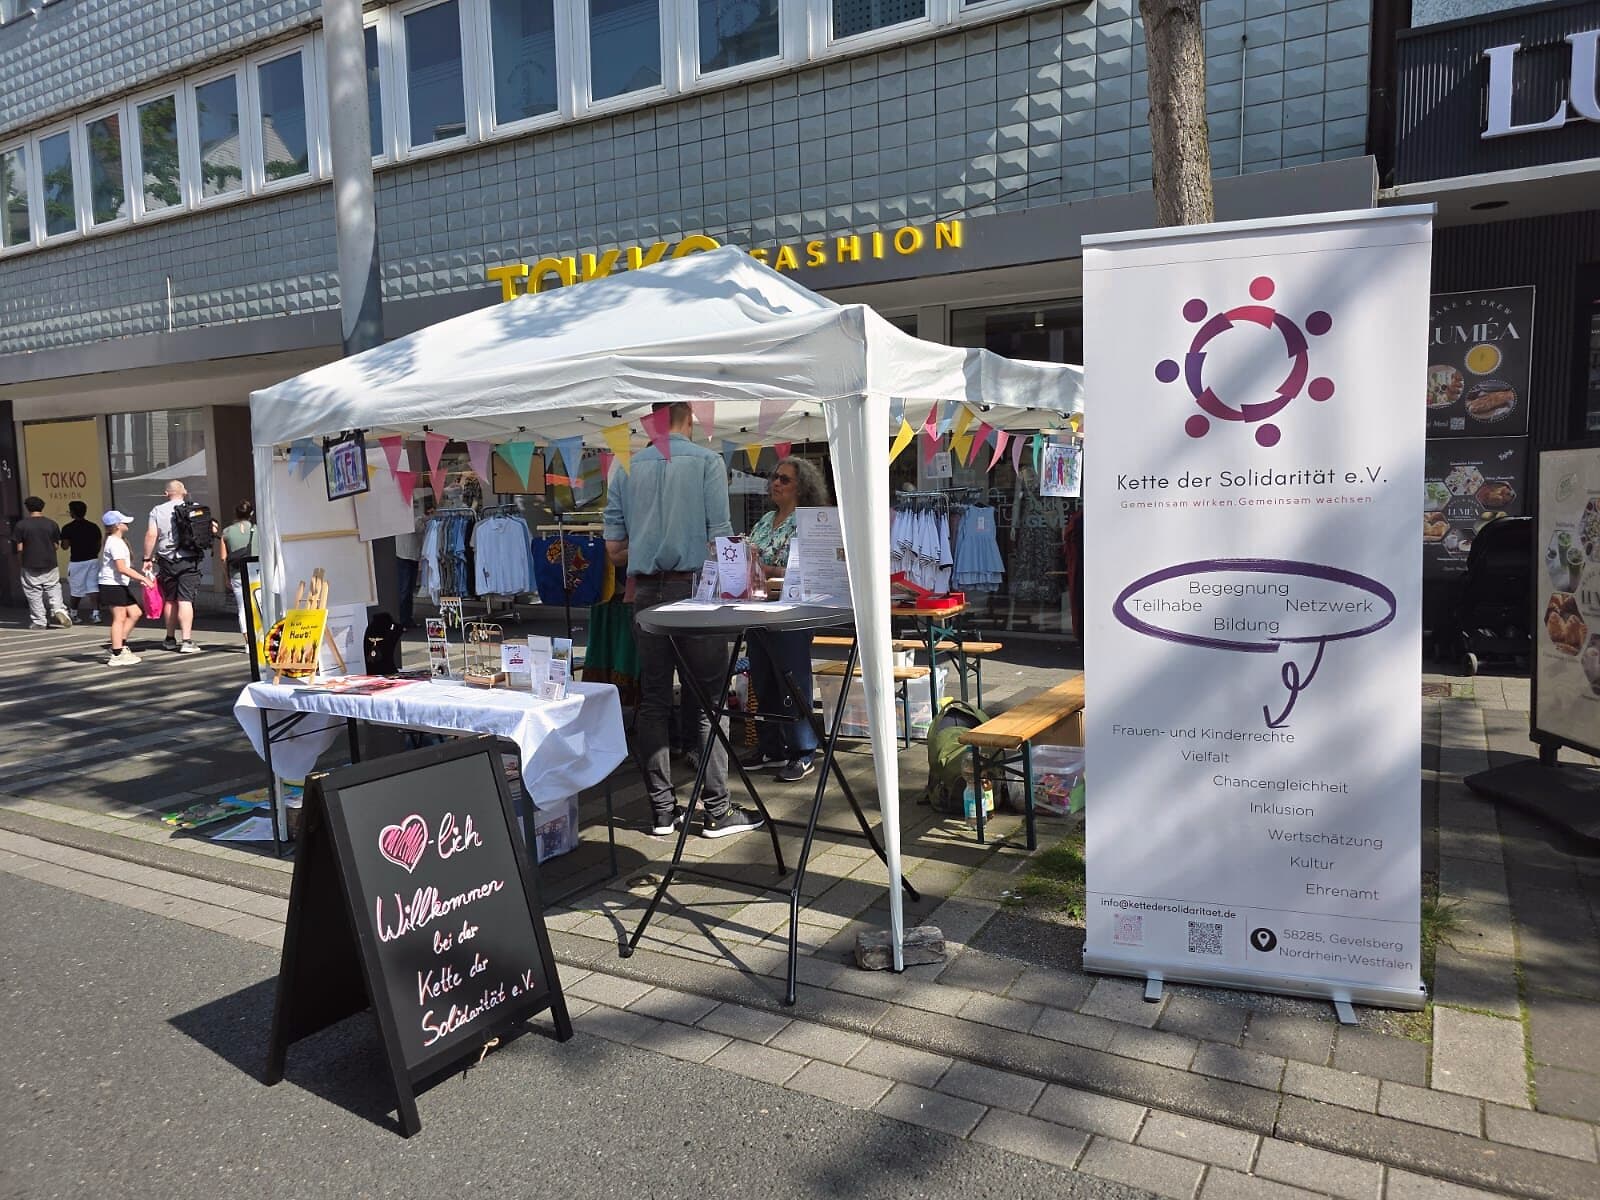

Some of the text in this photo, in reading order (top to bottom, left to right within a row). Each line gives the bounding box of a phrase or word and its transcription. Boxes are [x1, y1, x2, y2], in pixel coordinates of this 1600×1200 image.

[1429, 316, 1521, 346] UMÉA
[1117, 465, 1387, 490] Kette der Solidarität e.V.
[1120, 499, 1188, 509] Gemeinsam
[1188, 581, 1290, 597] Begegnung
[1132, 598, 1203, 613] Teilhabe
[1285, 598, 1374, 614] Netzwerk
[1213, 616, 1280, 634] Bildung
[1112, 724, 1296, 744] Frauen- und Kinderrechte
[1181, 749, 1231, 764] Vielfalt
[1212, 774, 1350, 794] Chancengleichheit
[1249, 801, 1315, 817] Inklusion
[1267, 828, 1384, 851] Wertschätzung
[1289, 855, 1336, 871] Kultur
[1305, 882, 1380, 901] Ehrenamt
[376, 879, 504, 943] Willkommen
[1100, 896, 1238, 919] info@kettedersolidaritaet.de
[433, 920, 480, 954] bei der
[1329, 933, 1405, 952] Gevelsberg
[1278, 945, 1414, 970] Nordrhein-Westfalen
[418, 952, 489, 1006] Kette der
[421, 968, 536, 1047] Solidarität e.V.
